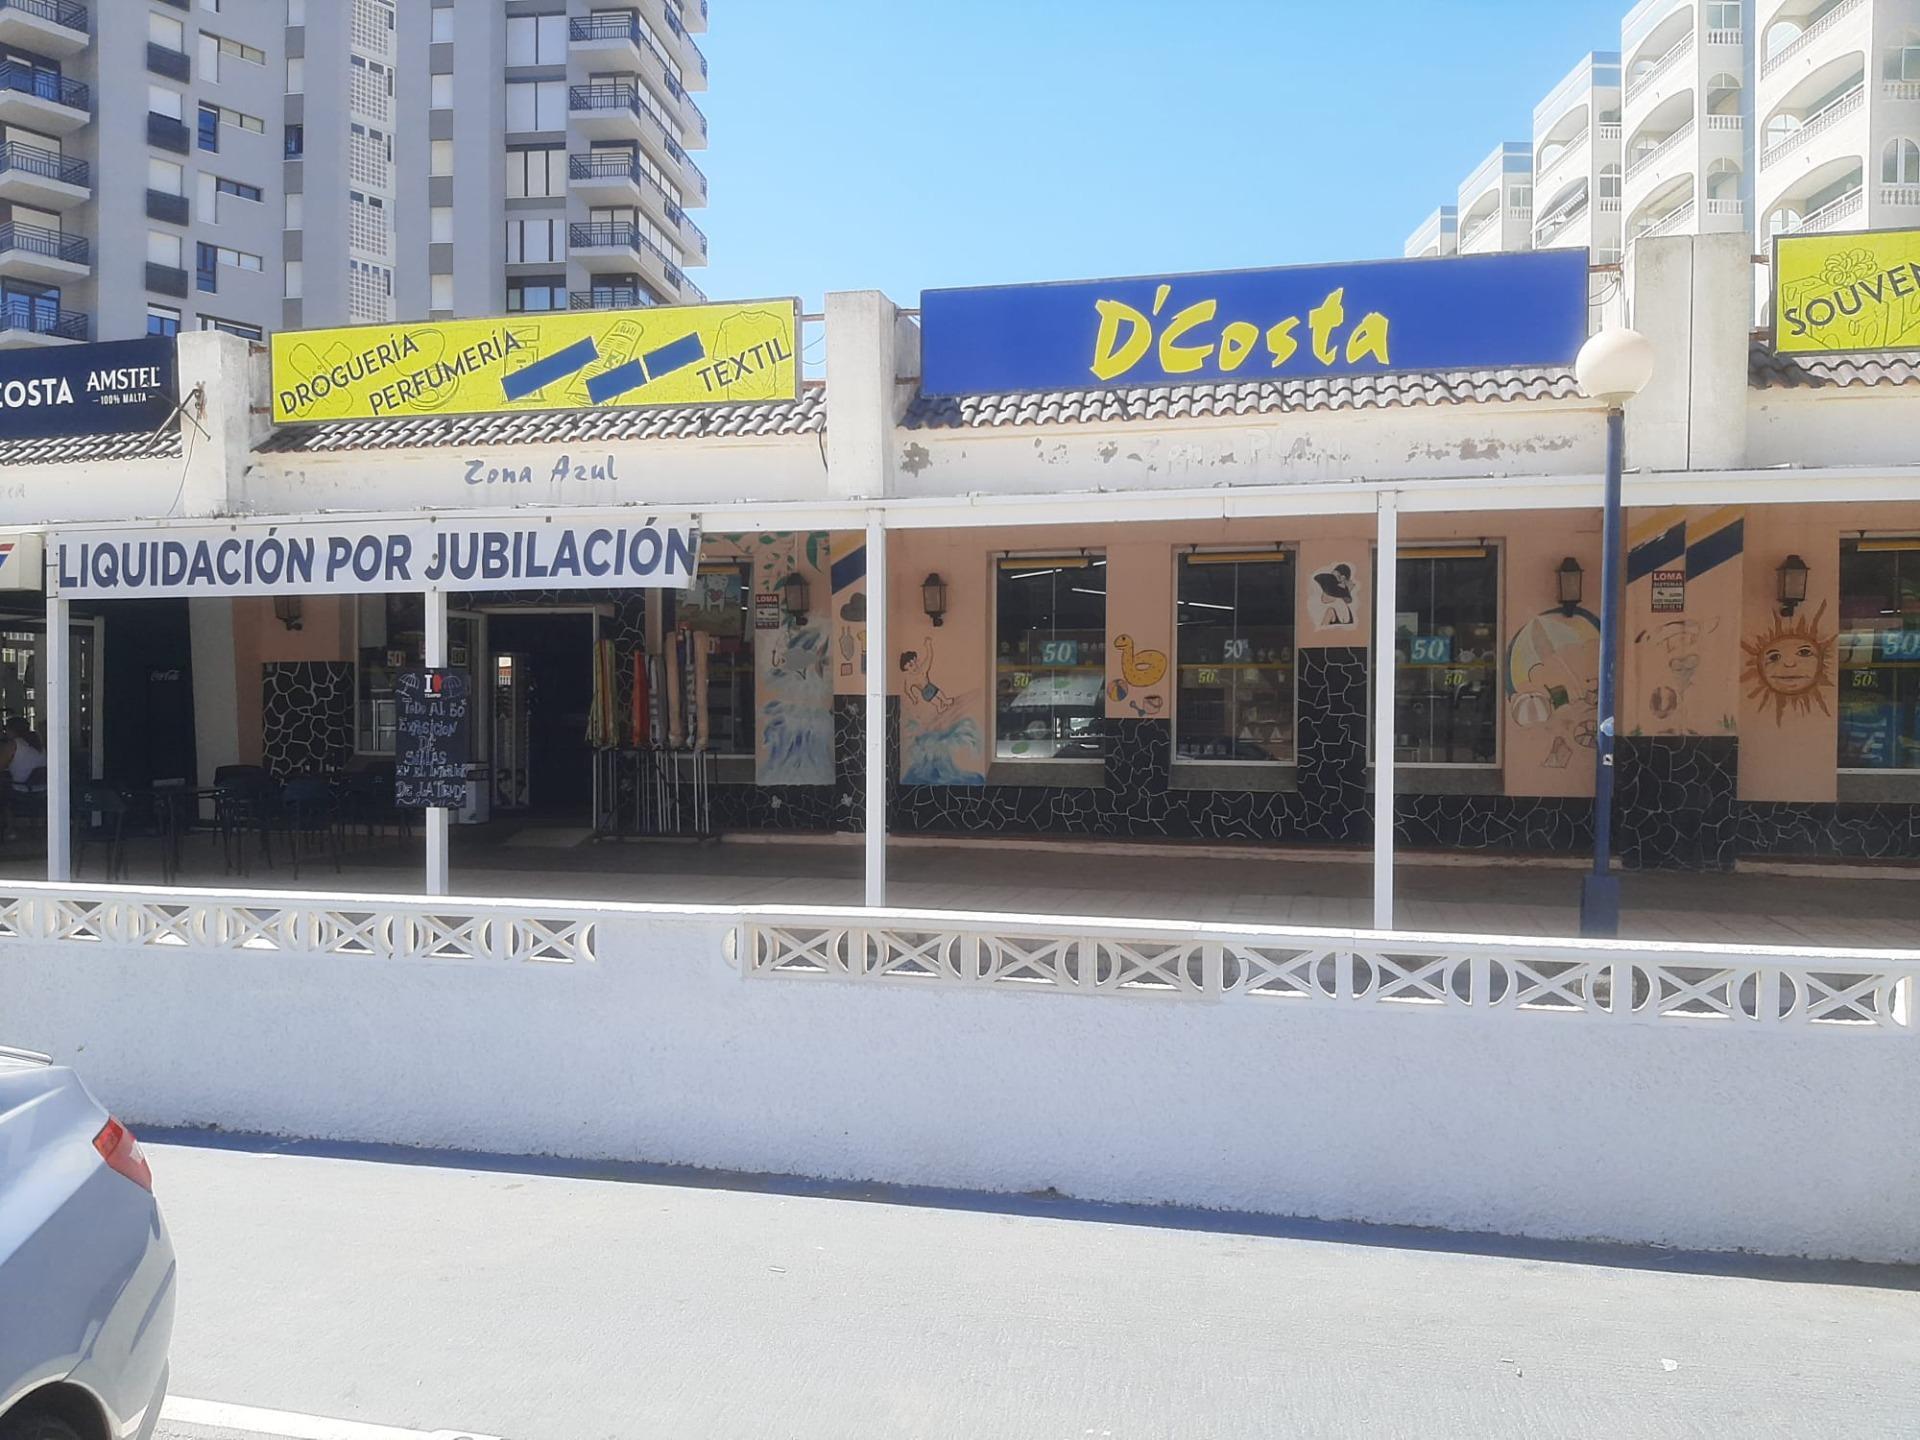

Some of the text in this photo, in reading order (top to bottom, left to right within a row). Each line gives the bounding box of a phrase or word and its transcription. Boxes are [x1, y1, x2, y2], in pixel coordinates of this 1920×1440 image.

[1089, 284, 1390, 381] D'Costa
[86, 366, 161, 392] AMSTEL
[280, 333, 420, 414] DROGUERÍA
[369, 330, 522, 415] PERFUMERÍA
[696, 337, 792, 393] TEXTIL
[0, 376, 75, 408] OSTA
[101, 392, 147, 406] 100% MALTA
[464, 455, 619, 485] Zona Azul
[58, 516, 699, 589] LIQUIDACIÓN POR JUBILACIÓN
[1653, 573, 1683, 581] LOMA
